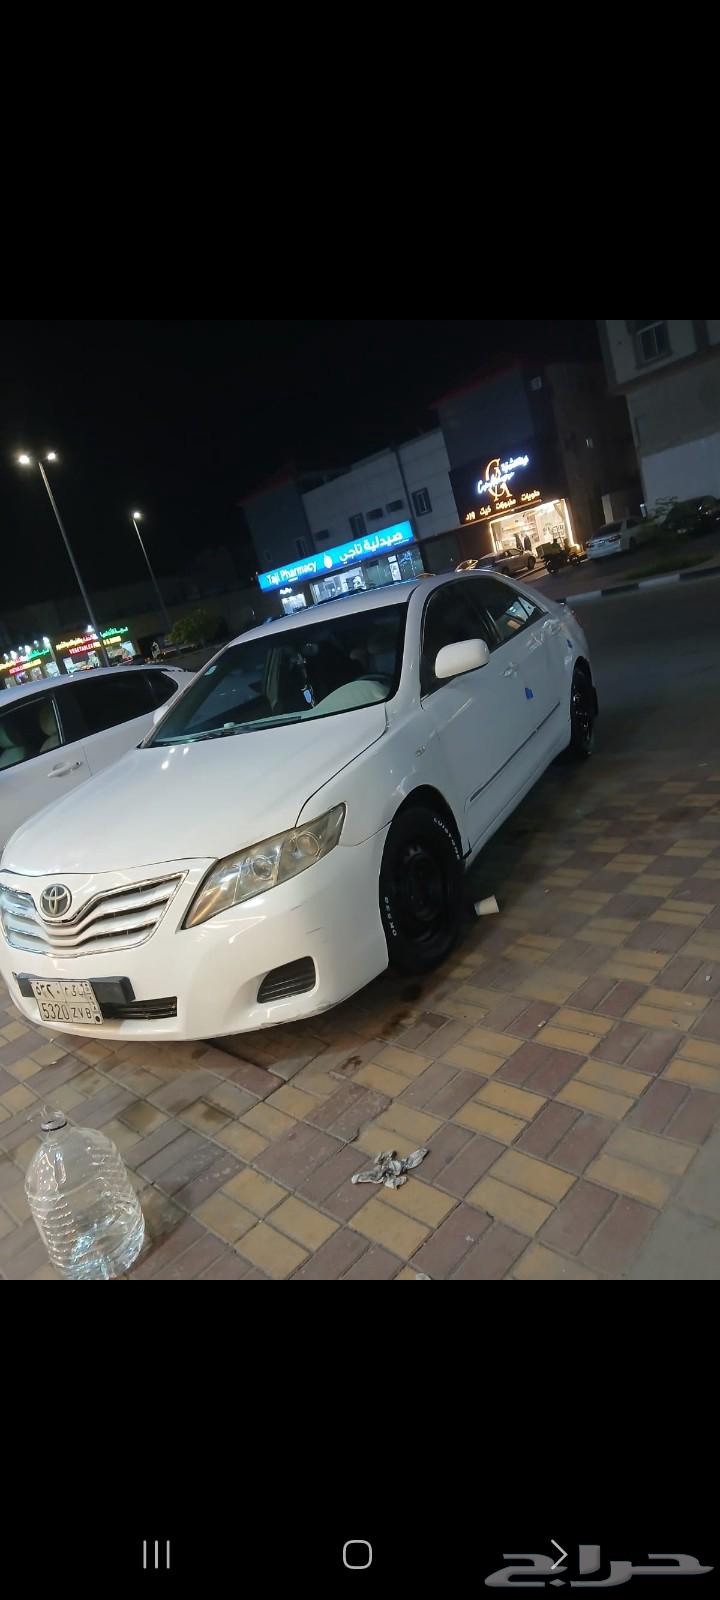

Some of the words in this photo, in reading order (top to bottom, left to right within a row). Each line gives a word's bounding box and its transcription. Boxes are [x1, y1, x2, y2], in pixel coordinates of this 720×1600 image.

[363, 532, 403, 552] صيدلية
[339, 543, 363, 564] تاجي
[266, 574, 280, 585] Taji
[280, 561, 317, 579] Pharmacy
[41, 1003, 70, 1020] 5320
